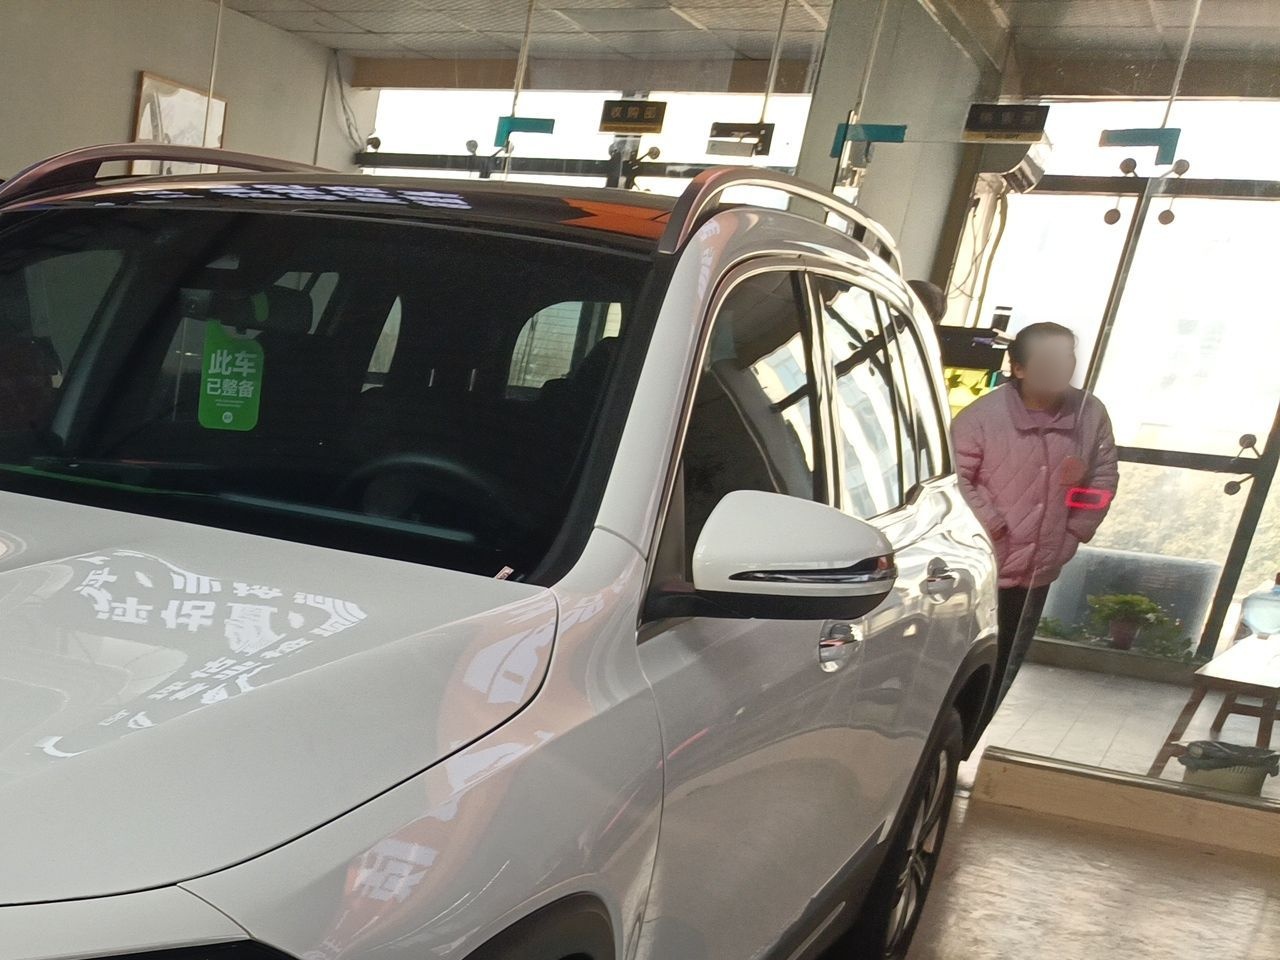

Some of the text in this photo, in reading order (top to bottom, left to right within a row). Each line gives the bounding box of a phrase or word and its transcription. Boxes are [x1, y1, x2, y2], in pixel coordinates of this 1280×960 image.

[208, 349, 258, 377] 此车
[207, 378, 254, 398] 已整备
